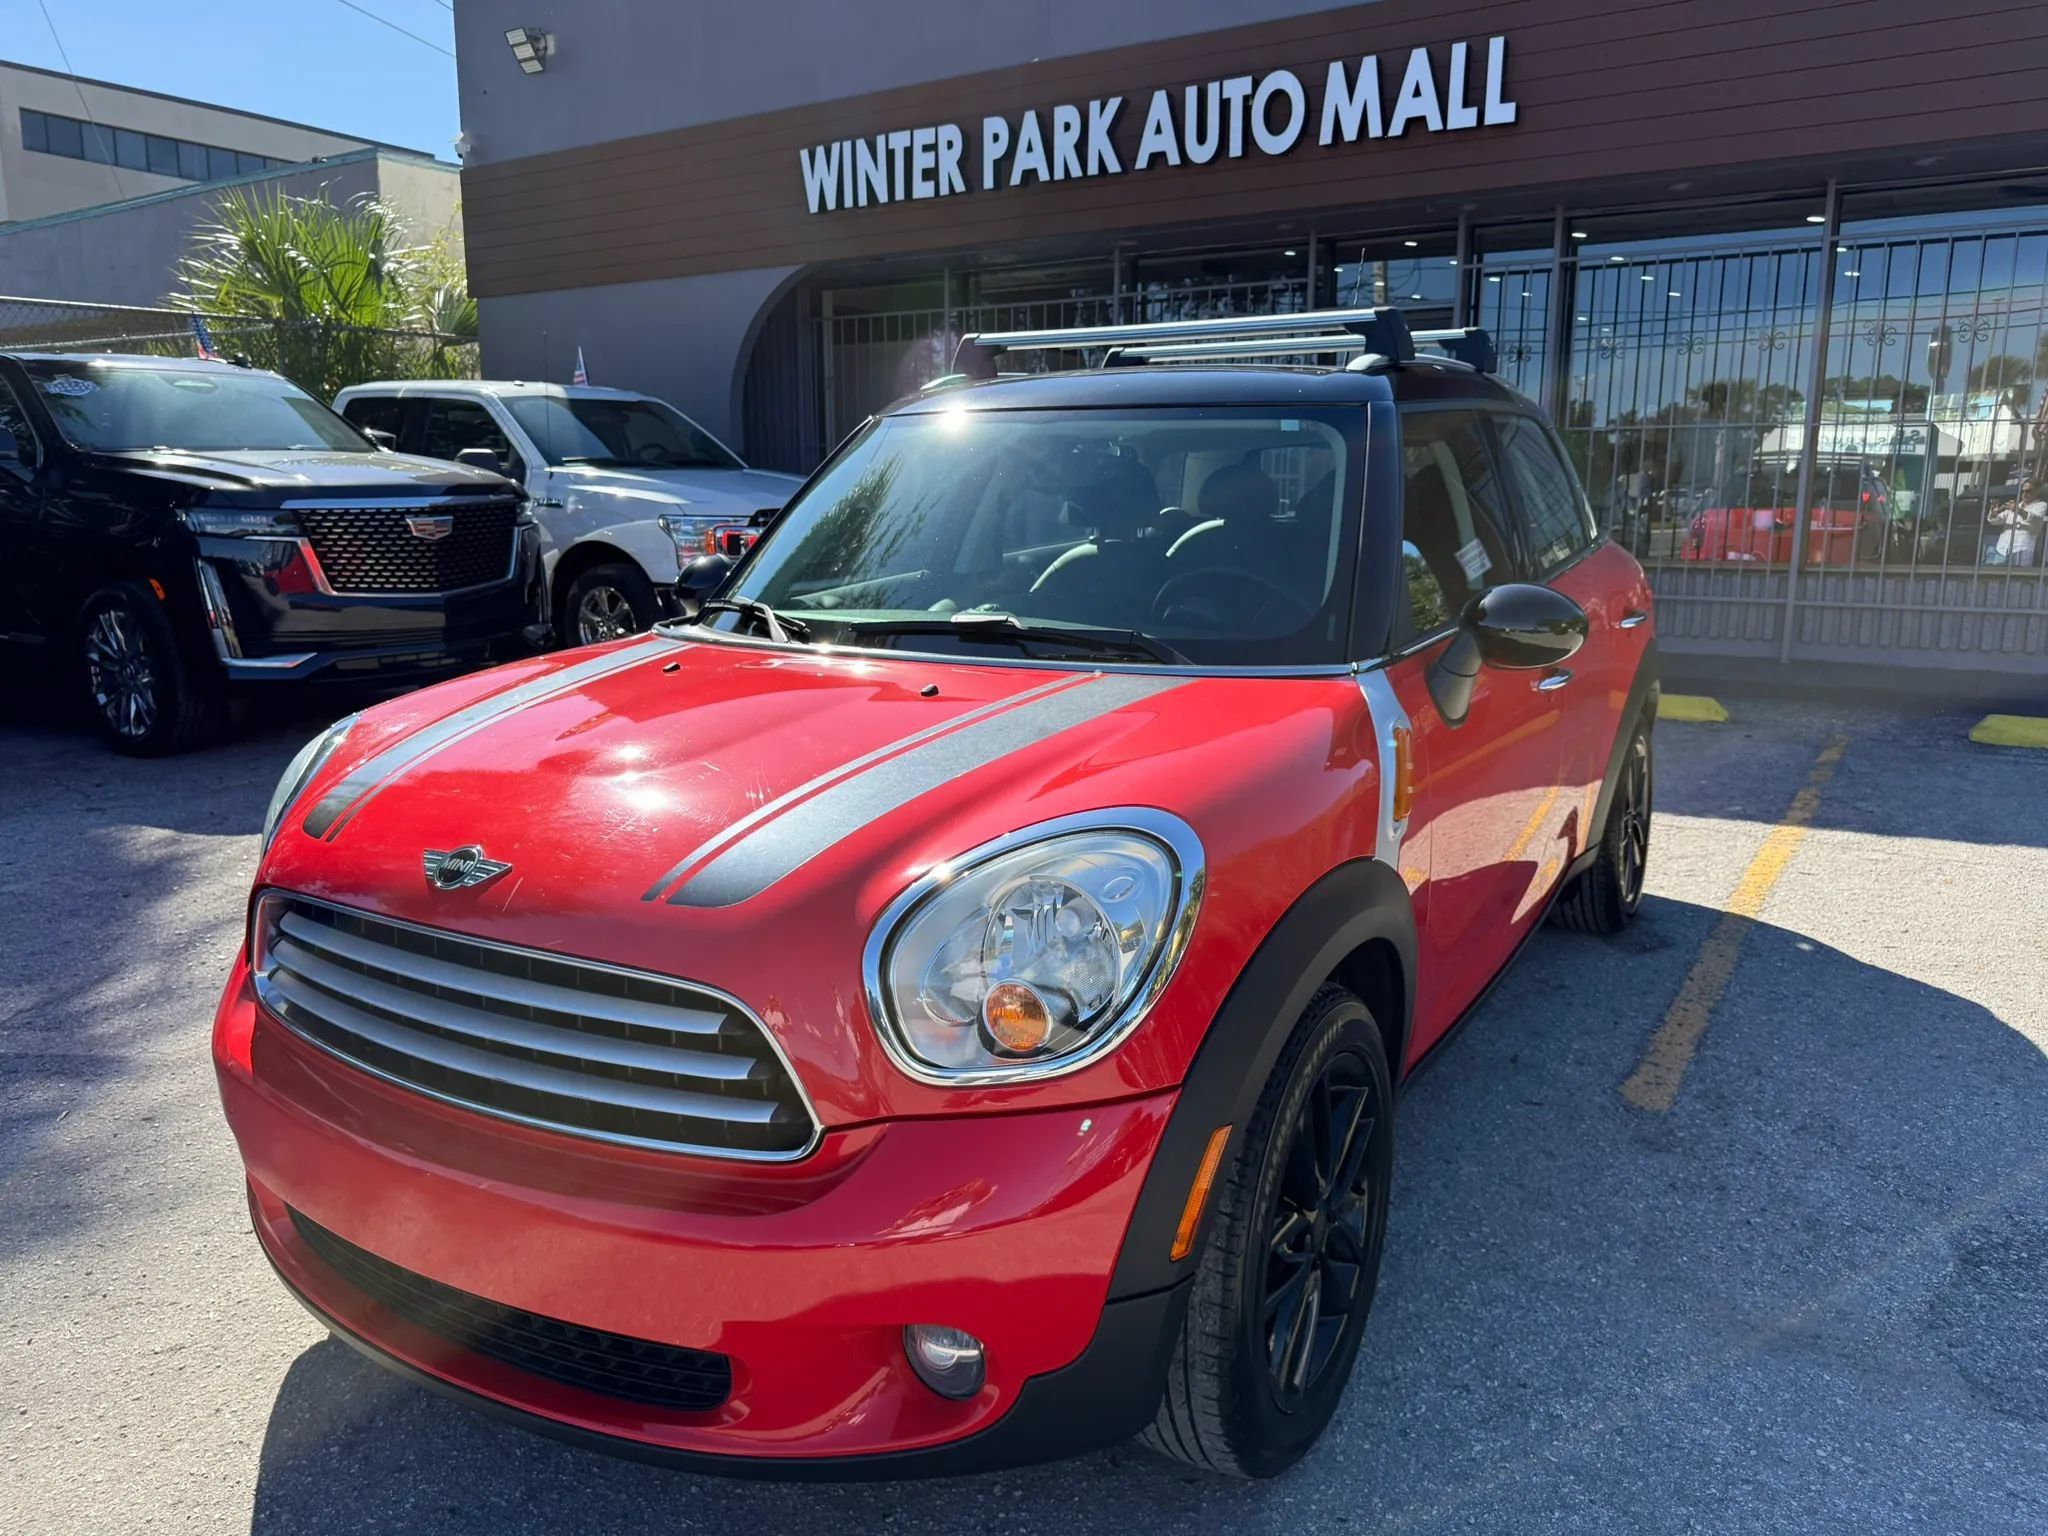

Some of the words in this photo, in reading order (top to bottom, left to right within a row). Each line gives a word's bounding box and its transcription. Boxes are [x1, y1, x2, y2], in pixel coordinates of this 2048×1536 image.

[800, 124, 966, 213] WINTER
[983, 97, 1122, 189] PARK
[1135, 70, 1305, 169] AUTO
[1319, 36, 1516, 146] MALL
[441, 857, 474, 872] MINI
